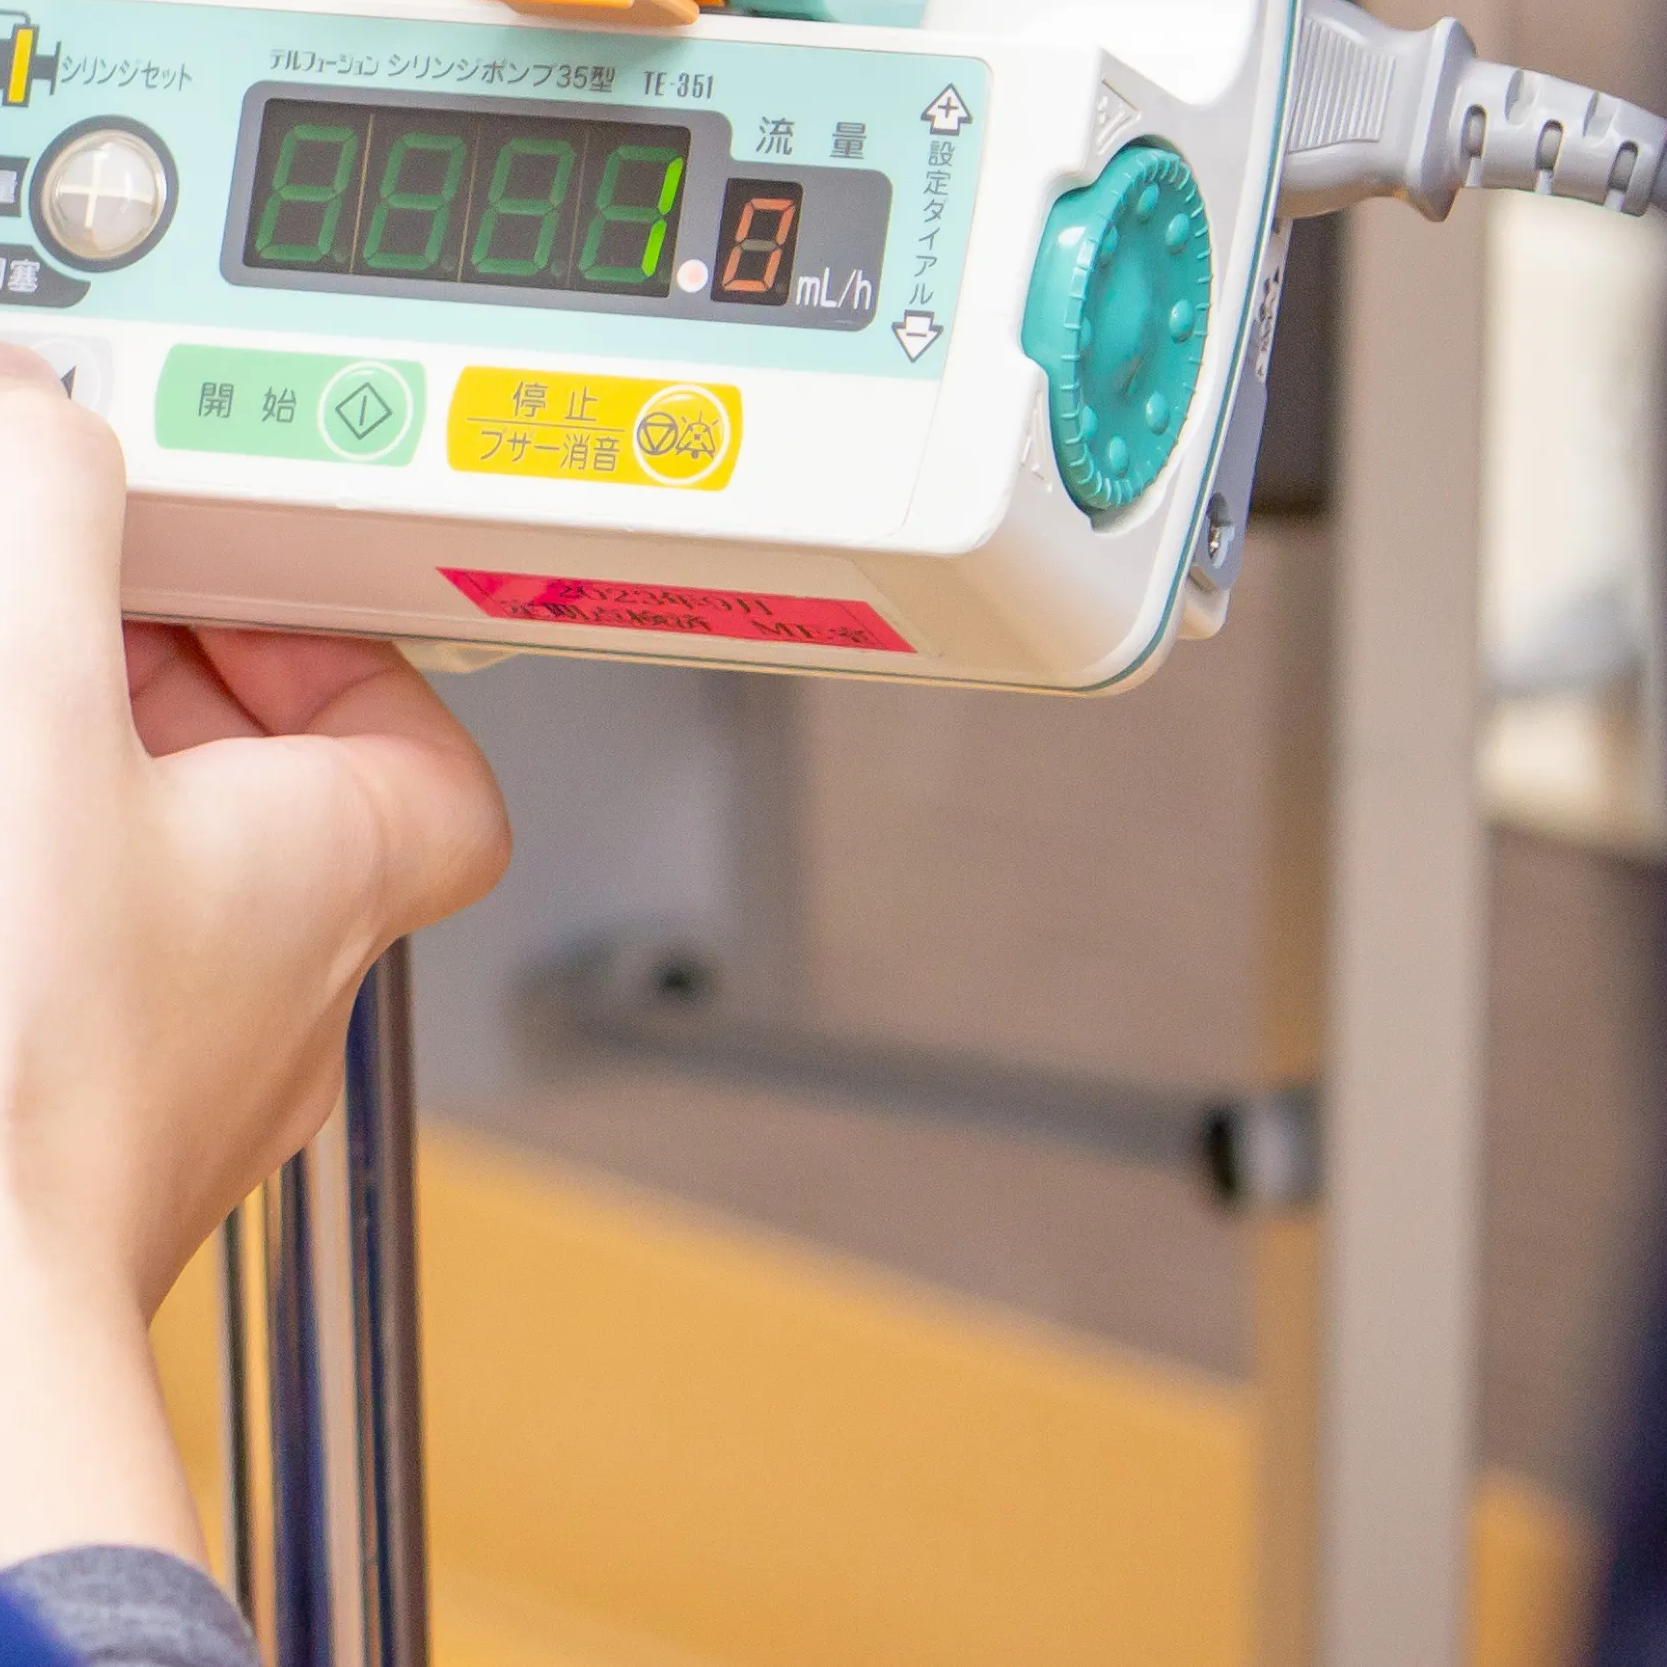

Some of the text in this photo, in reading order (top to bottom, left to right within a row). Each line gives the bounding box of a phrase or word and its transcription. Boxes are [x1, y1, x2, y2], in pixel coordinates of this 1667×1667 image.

[60, 54, 193, 92] シリンジセット
[642, 69, 715, 100] TE-351
[755, 115, 868, 161] 流量
[908, 139, 957, 306] 設定ダイアル
[795, 266, 874, 311] mL/h
[197, 381, 298, 424] 開始
[512, 380, 599, 423] 停止
